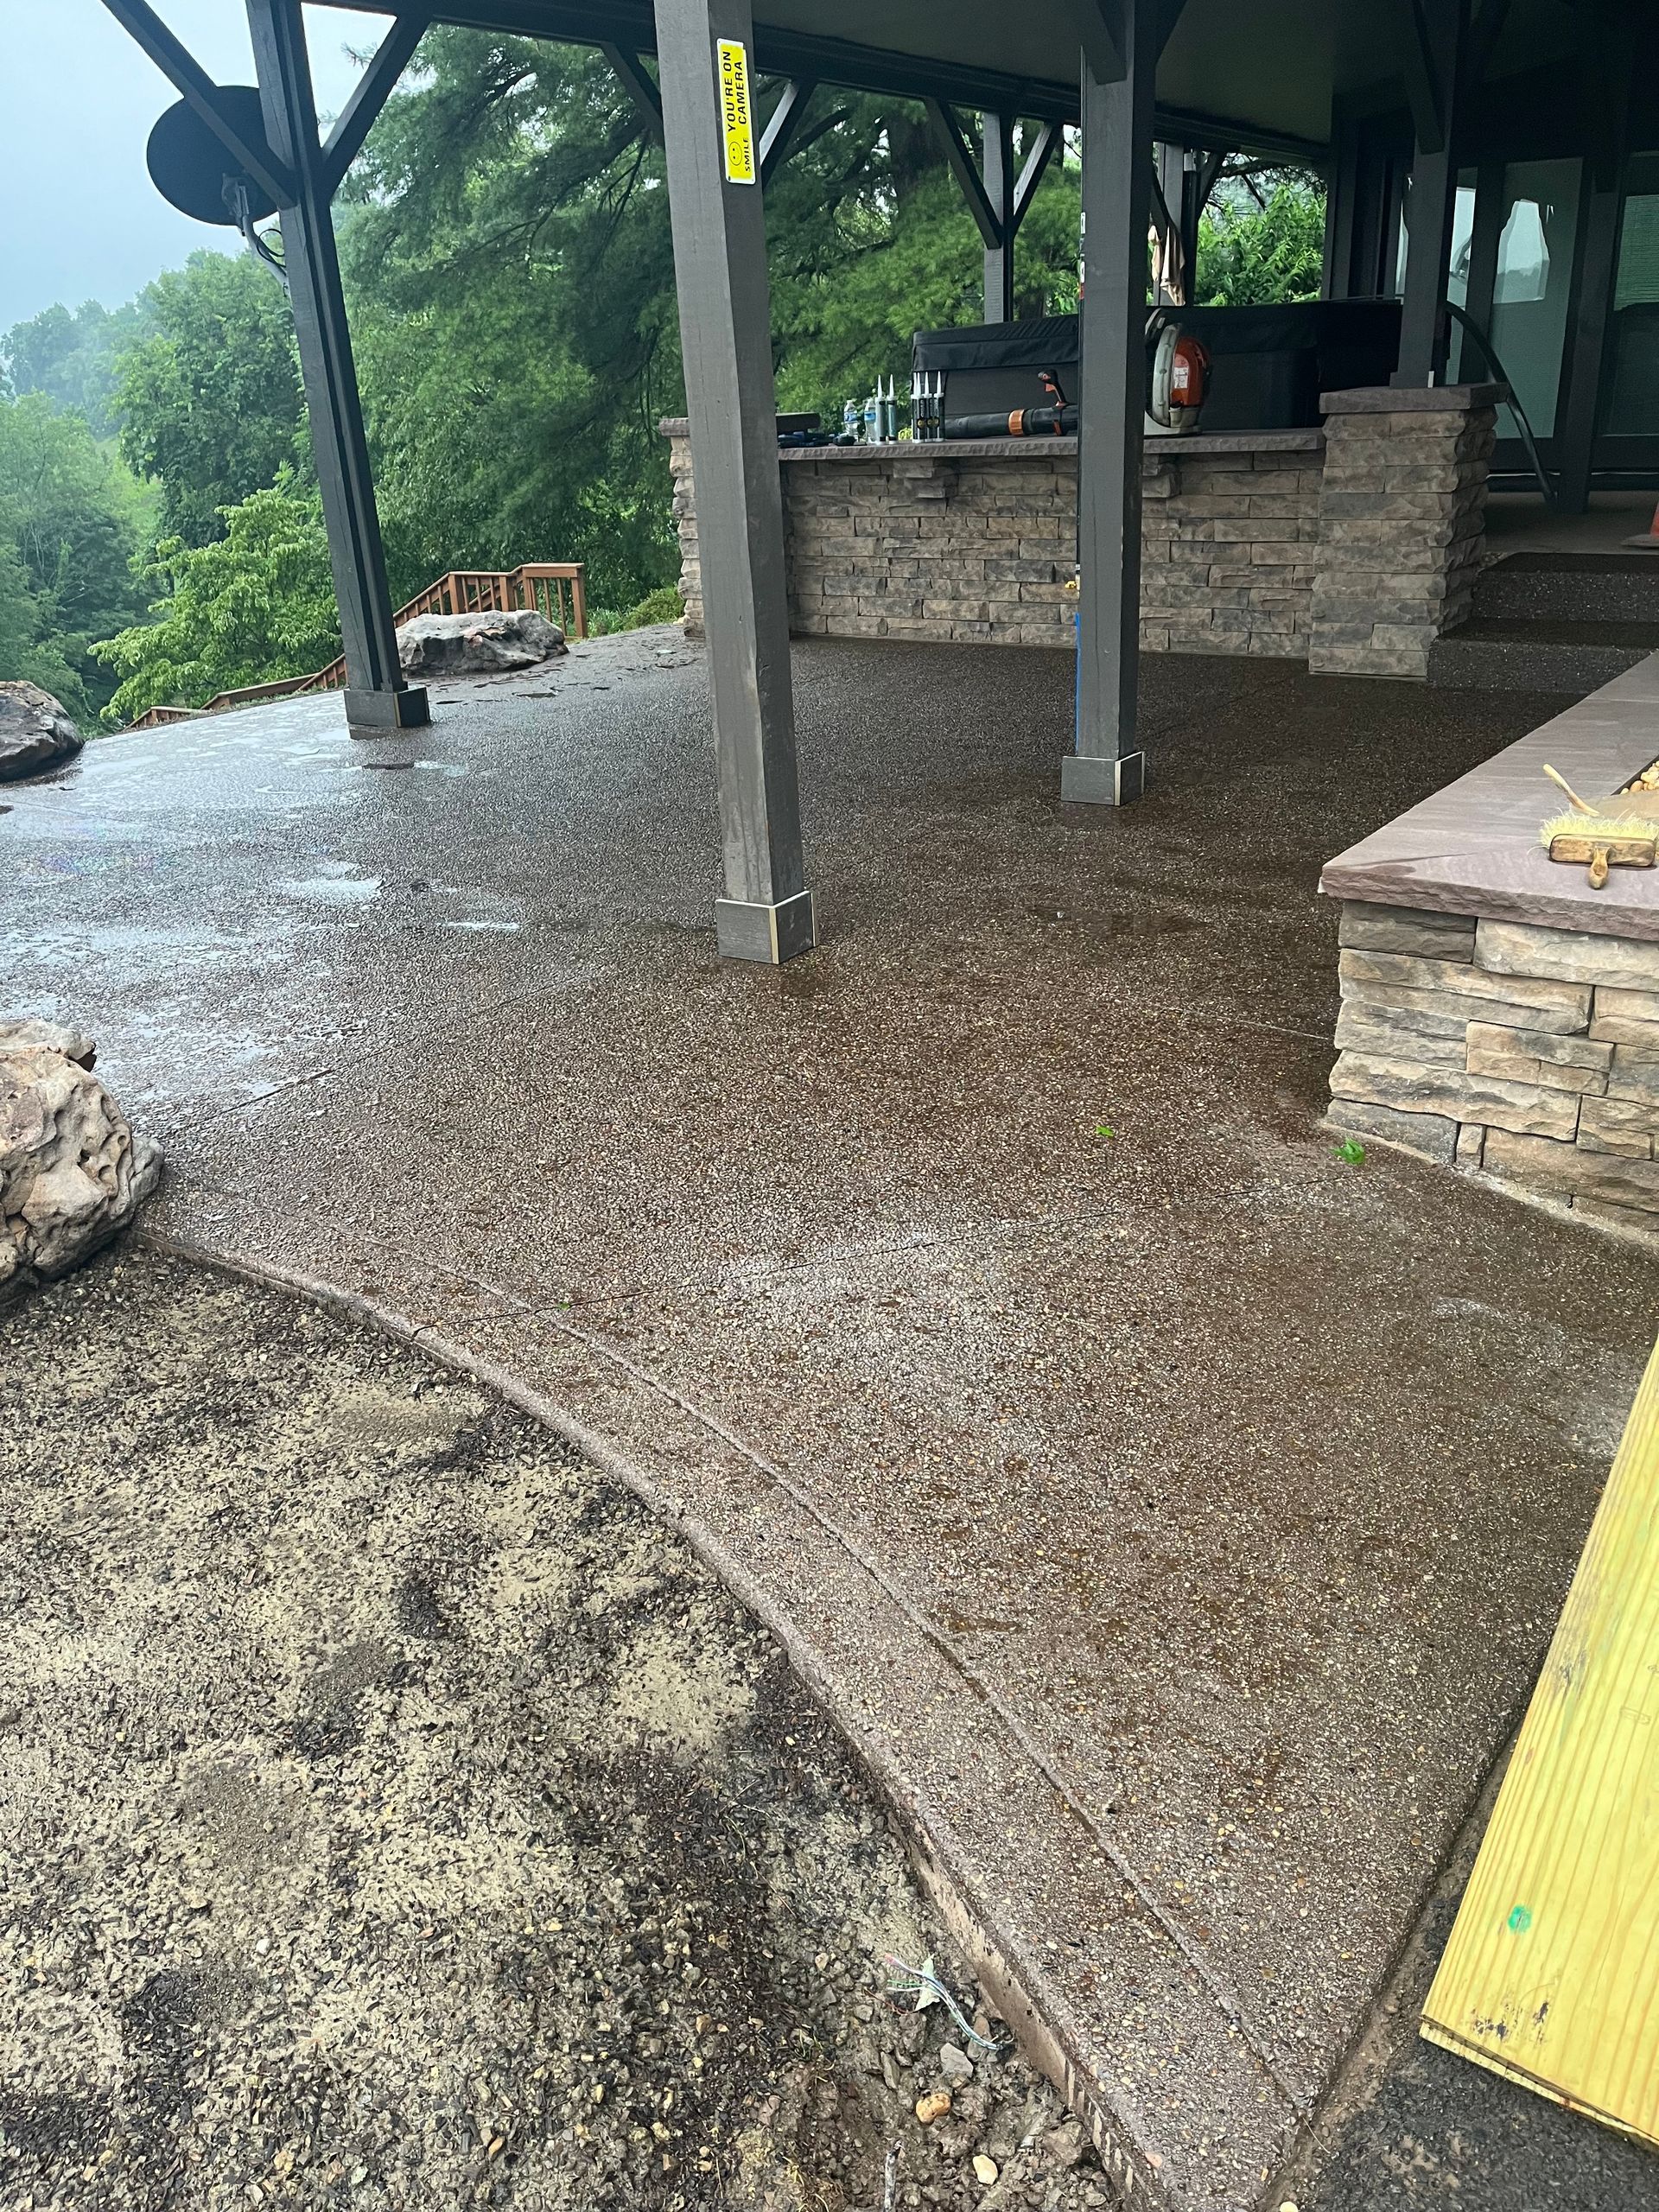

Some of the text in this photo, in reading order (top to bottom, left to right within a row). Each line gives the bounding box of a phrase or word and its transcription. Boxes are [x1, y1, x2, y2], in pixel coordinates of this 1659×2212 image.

[722, 51, 736, 132] YOU'RE ON
[734, 61, 747, 124] CAMERA
